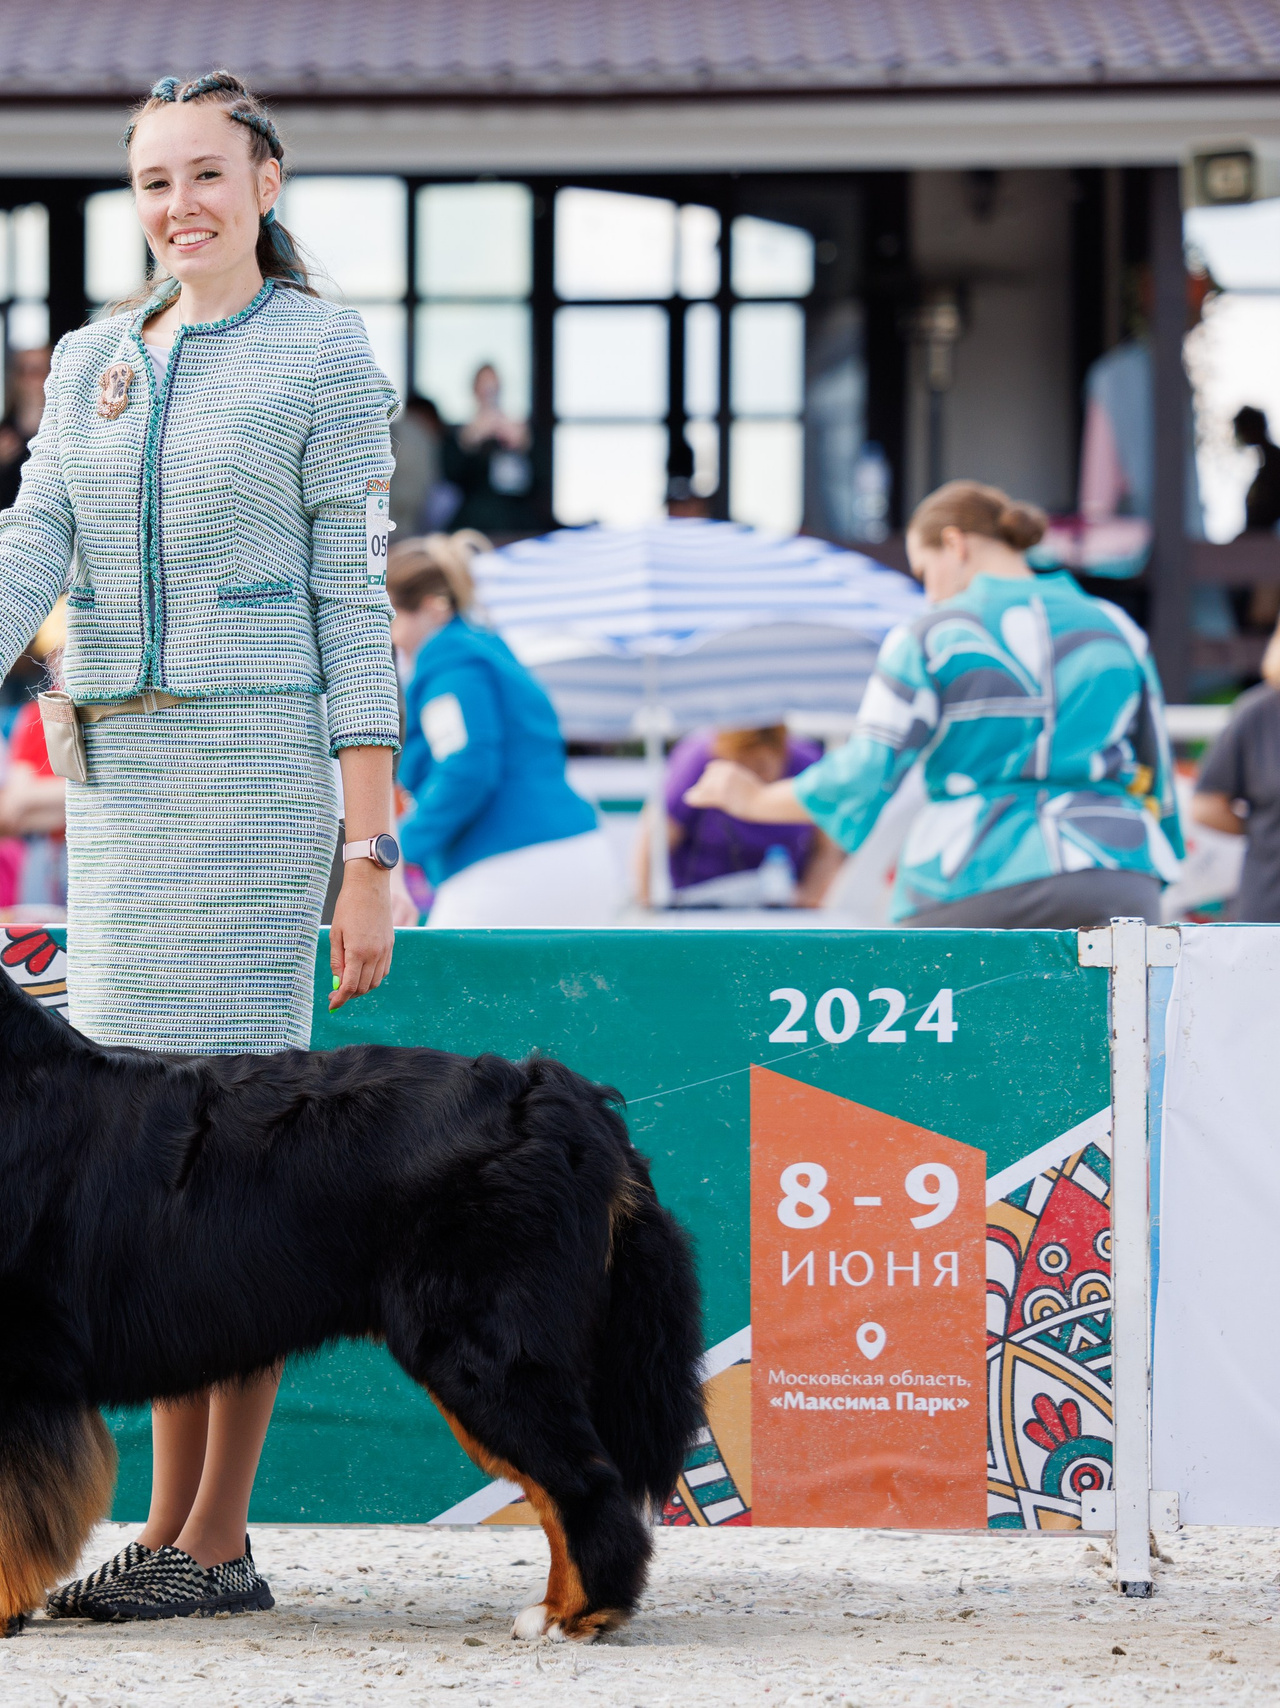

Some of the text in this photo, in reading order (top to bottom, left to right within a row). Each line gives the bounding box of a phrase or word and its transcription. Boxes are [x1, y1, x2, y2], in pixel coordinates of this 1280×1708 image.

[768, 987, 958, 1043] 2024
[776, 1162, 831, 1229] 8
[904, 1162, 959, 1230] 9
[768, 1369, 972, 1388] Московская область,
[769, 1391, 970, 1417] «Максима Парк»
